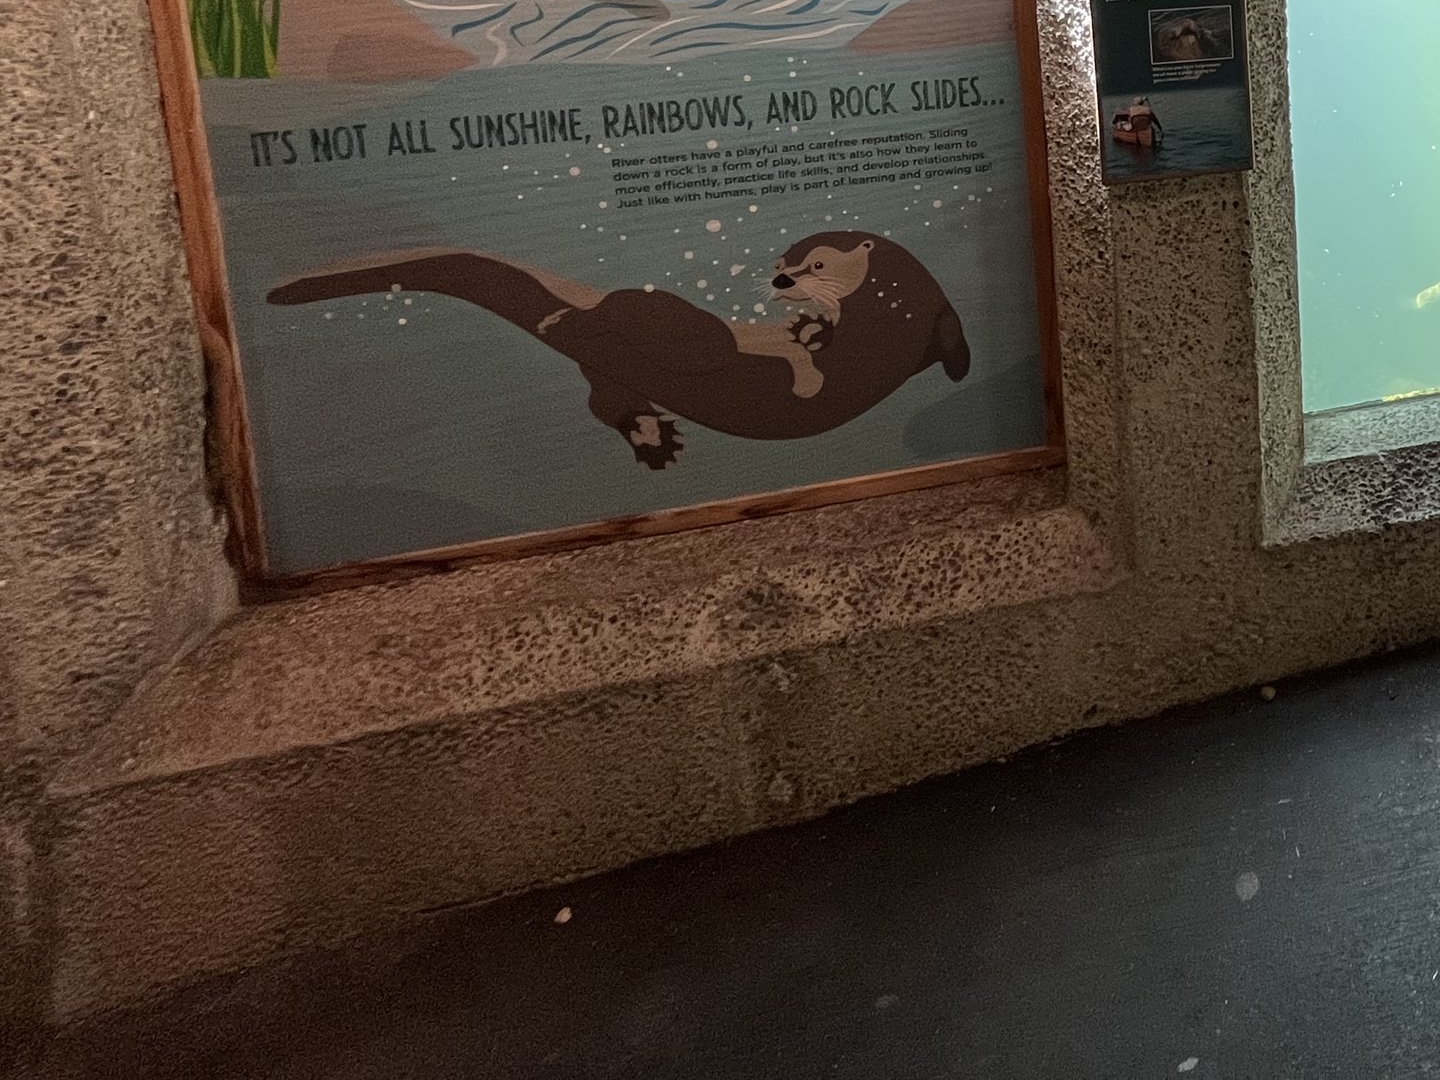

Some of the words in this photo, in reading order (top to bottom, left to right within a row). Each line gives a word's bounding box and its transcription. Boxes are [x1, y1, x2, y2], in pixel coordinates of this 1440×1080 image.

[251, 130, 298, 166] IT'S
[310, 124, 367, 162] NOT
[388, 121, 436, 156] ALL
[450, 108, 591, 150] SUNSHINE,
[602, 95, 754, 139] RAINBOWS,
[767, 90, 817, 124] AND
[830, 83, 898, 119] ROCK
[911, 76, 1004, 112] SLIDES...
[612, 159, 644, 168] River
[650, 154, 687, 165] otters
[691, 151, 720, 160] have
[737, 144, 778, 157] playful
[782, 143, 804, 152] and
[809, 138, 858, 149] carefree
[862, 132, 925, 145] reputation.
[929, 128, 968, 140] Sliding
[613, 171, 649, 181] down
[665, 165, 693, 176] rock
[723, 161, 751, 171] form
[773, 156, 800, 167] play,
[804, 154, 824, 163] but
[829, 152, 845, 161] it's
[850, 151, 873, 159] also
[877, 148, 901, 156] how
[905, 145, 929, 154] they
[934, 141, 962, 150] learn
[615, 186, 649, 195] move
[655, 177, 721, 190] efficiently,
[725, 172, 774, 185] practice
[778, 170, 796, 179] life
[801, 167, 833, 177] skills,
[836, 164, 858, 173] and
[863, 160, 909, 171] develop
[617, 197, 643, 208] Just
[649, 195, 669, 205] like
[674, 192, 700, 202] with
[705, 188, 756, 200] humans,
[761, 184, 787, 195] play
[804, 181, 829, 190] part
[849, 174, 895, 185] learning
[900, 170, 921, 179] and
[925, 166, 972, 178] growing
[975, 163, 993, 173] up!
